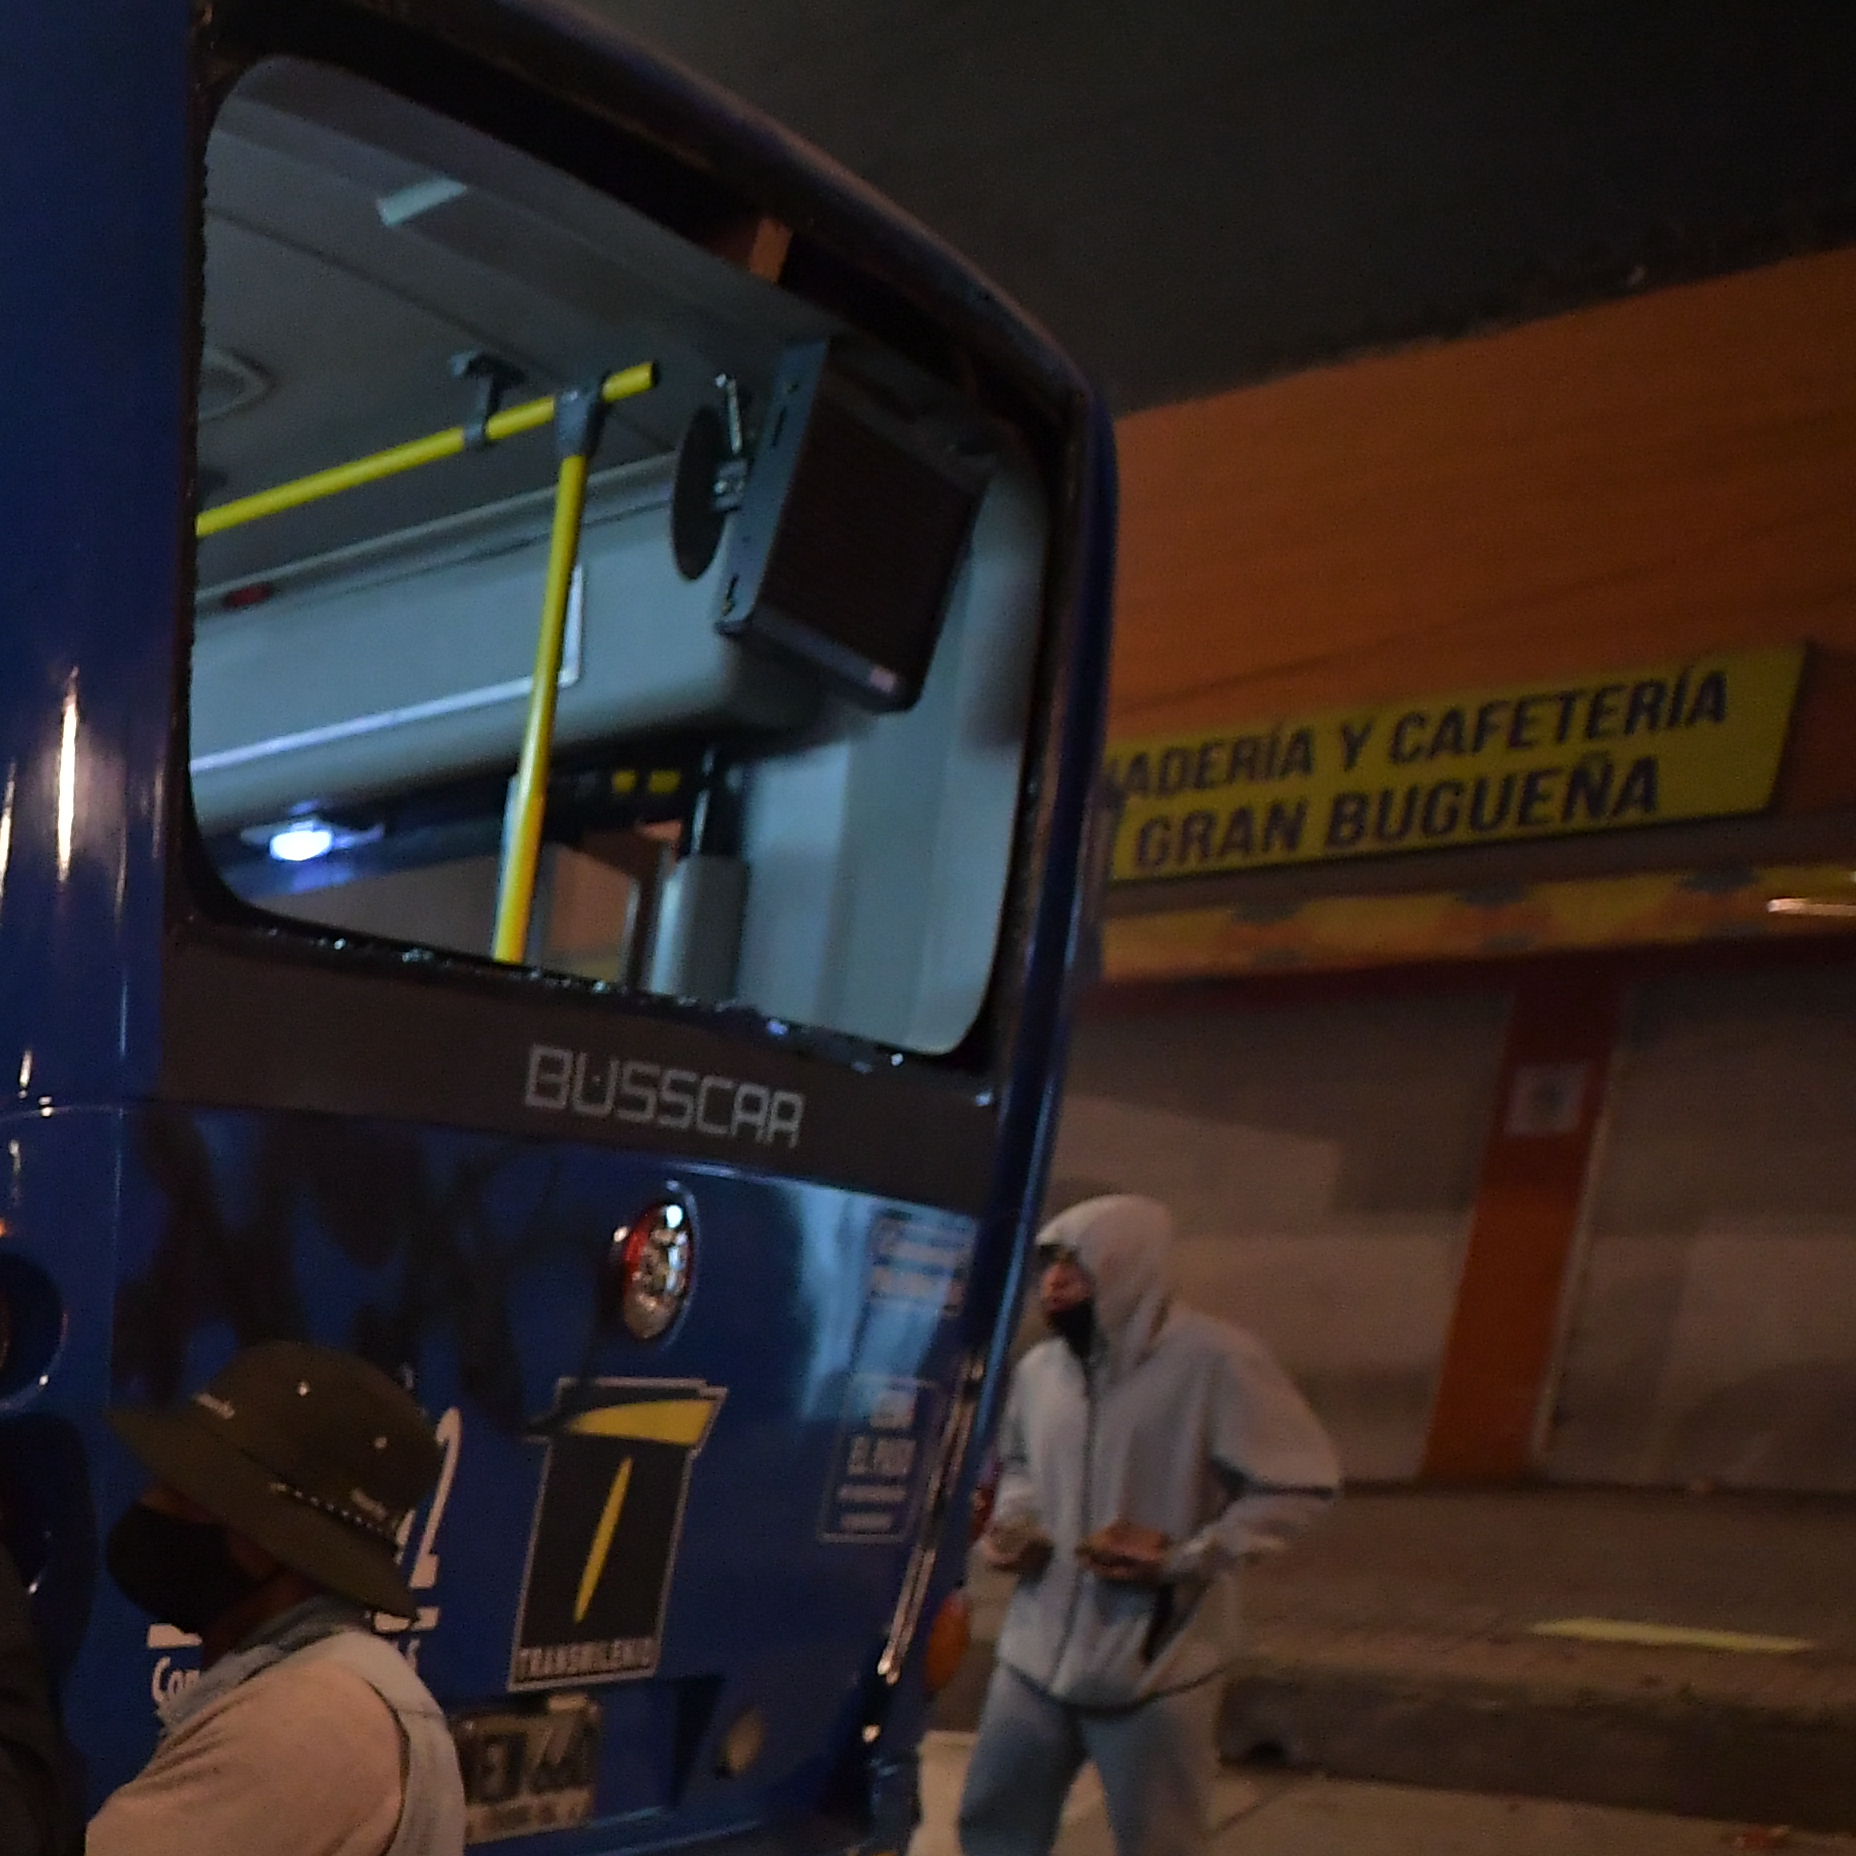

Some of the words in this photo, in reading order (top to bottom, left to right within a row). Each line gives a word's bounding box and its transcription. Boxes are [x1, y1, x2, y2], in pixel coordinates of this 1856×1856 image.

[1339, 722, 1375, 772] Y
[1388, 667, 1729, 768] CAFETERÍA
[1135, 797, 1309, 872] GRAN
[1325, 751, 1661, 850] BUGUEÑA
[525, 1043, 806, 1149] BUSSCAR
